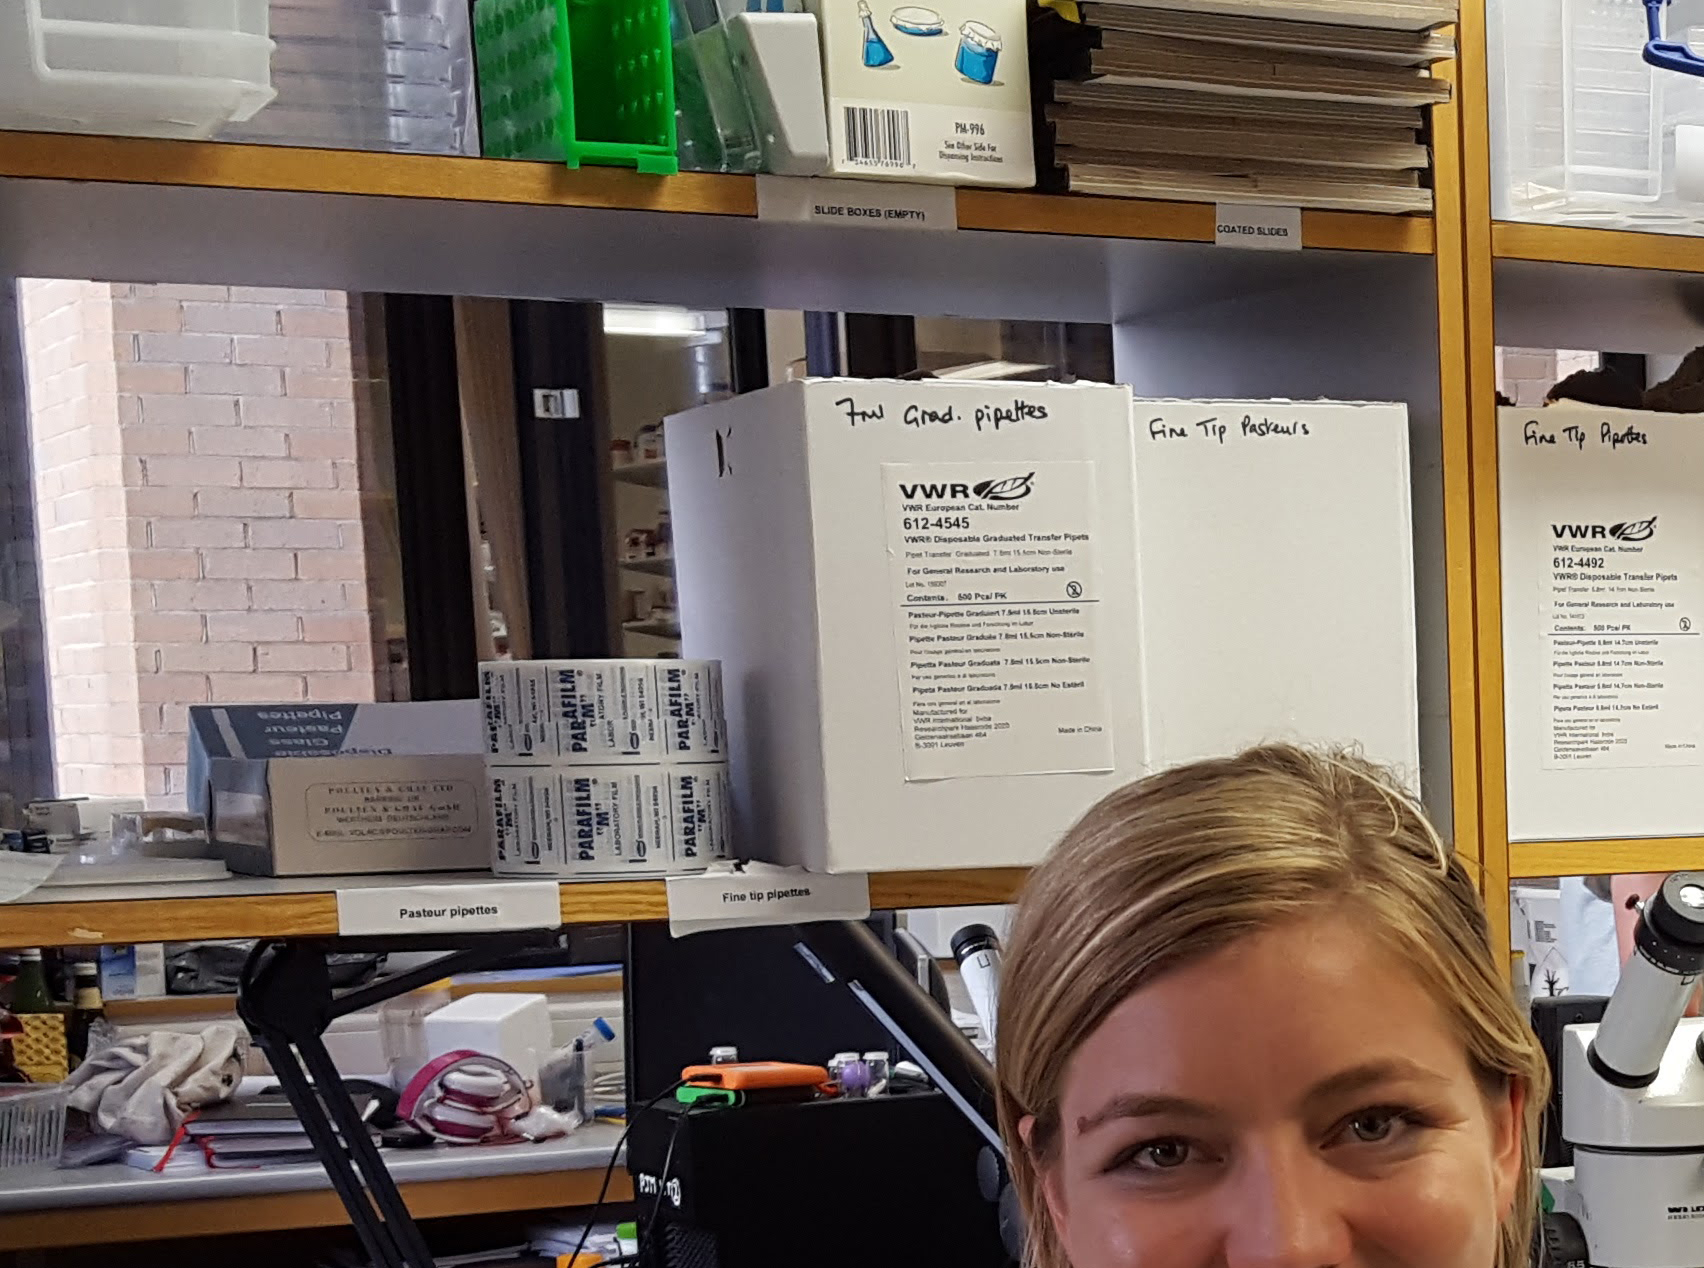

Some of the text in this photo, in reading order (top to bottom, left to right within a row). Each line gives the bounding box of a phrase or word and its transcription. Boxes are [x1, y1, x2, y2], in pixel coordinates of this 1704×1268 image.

[955, 121, 985, 136] PM-996
[814, 205, 925, 221] SLIDE BOXES (EMPTY)
[1217, 225, 1288, 236] COATED SLIDES
[904, 404, 961, 428] Grad.
[975, 399, 1048, 431] pipettes
[1150, 415, 1310, 444] Fine Tip Pasteurs
[1524, 420, 1556, 445] Fine
[1562, 426, 1586, 450] Tip
[899, 483, 970, 500] VWR
[902, 503, 1019, 513] VWR European Cat. Number
[903, 517, 970, 530] 612-4545
[1551, 524, 1606, 539] VWR
[934, 535, 980, 545] Disposable
[983, 534, 1026, 543] Graduated
[1028, 533, 1062, 542] Transfer
[1064, 533, 1089, 542] Pipets
[907, 567, 920, 575] For
[922, 567, 953, 575] General
[955, 566, 989, 574] Research
[1009, 565, 1049, 575] Laboratory
[1553, 557, 1605, 568] 612-4492
[1580, 573, 1621, 582] Disposable
[1624, 573, 1654, 581] Transfer
[1656, 573, 1678, 582] Pipets
[559, 669, 588, 752] PARAFILM
[667, 668, 691, 750] PARAFILM
[269, 737, 329, 747] Glass
[494, 778, 506, 860] PARAFILM
[574, 778, 595, 860] PARAFILM
[680, 775, 698, 858] PARAFILM
[612, 802, 623, 856] LABORATORY
[722, 886, 811, 903] Fine tip pipettes
[399, 904, 498, 919] Pasteur pipettes
